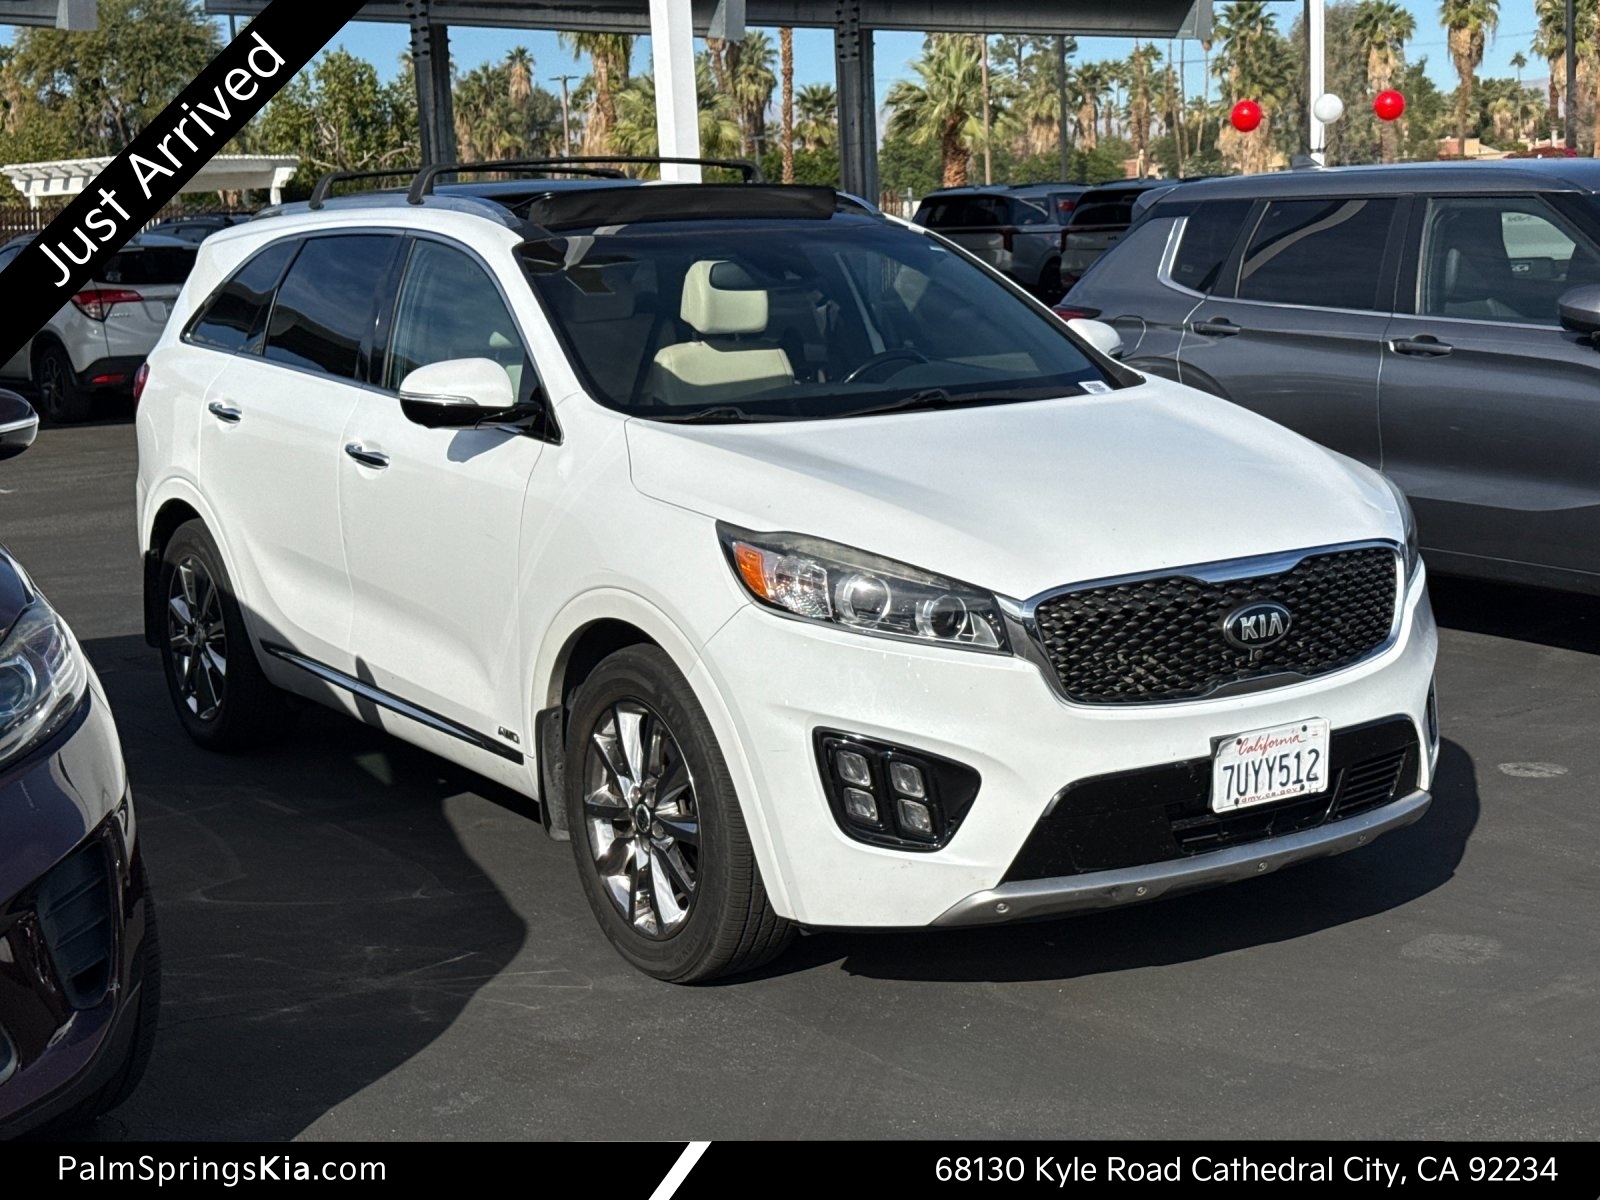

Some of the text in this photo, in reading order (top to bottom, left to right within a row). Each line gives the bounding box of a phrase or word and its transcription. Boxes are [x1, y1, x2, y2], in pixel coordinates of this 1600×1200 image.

[1240, 612, 1283, 640] KIA
[1239, 730, 1306, 756] California
[1222, 748, 1320, 801] 7UYY512
